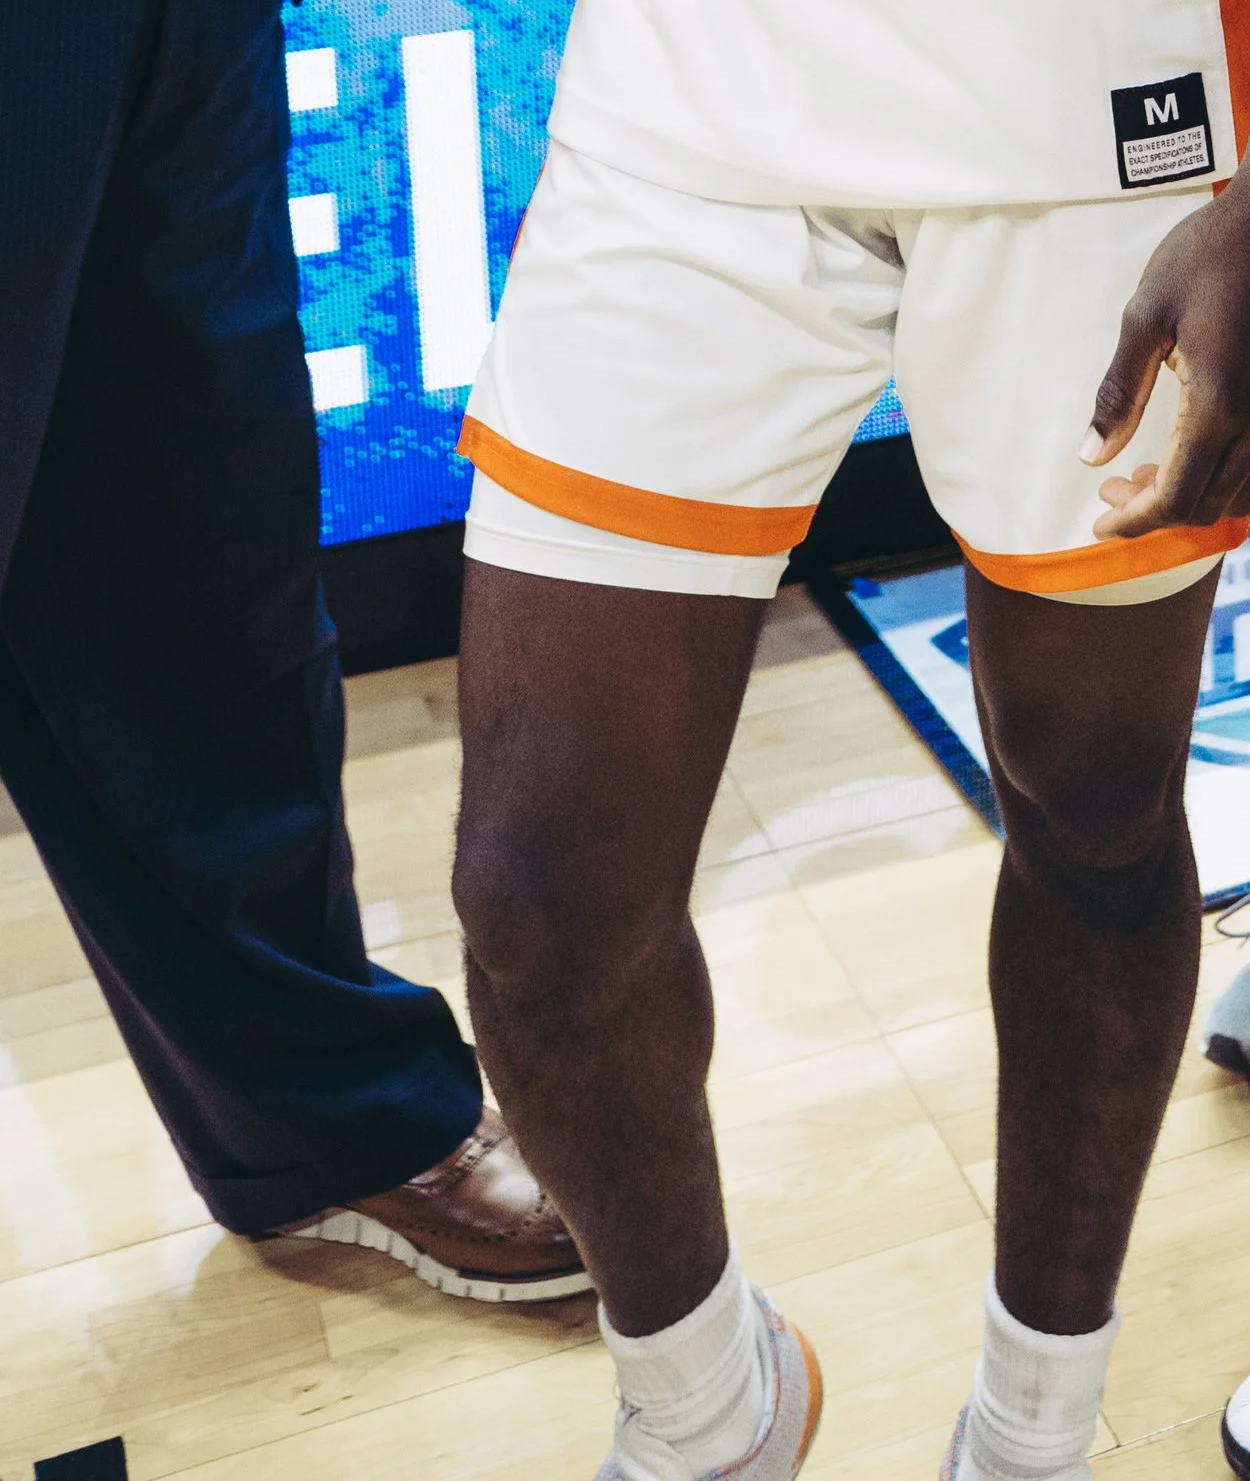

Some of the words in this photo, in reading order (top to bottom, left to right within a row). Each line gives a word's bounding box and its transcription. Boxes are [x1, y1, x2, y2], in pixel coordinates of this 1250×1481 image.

[1144, 93, 1179, 125] M
[1127, 138, 1176, 154] ENGINEERED
[1177, 135, 1186, 144] TO
[1188, 131, 1202, 141] THE
[1129, 155, 1149, 166] EXACT
[1150, 144, 1193, 162] SPECIFICATIONS
[1194, 142, 1202, 151] OF
[1130, 161, 1177, 177] CHAMPIONSHIP
